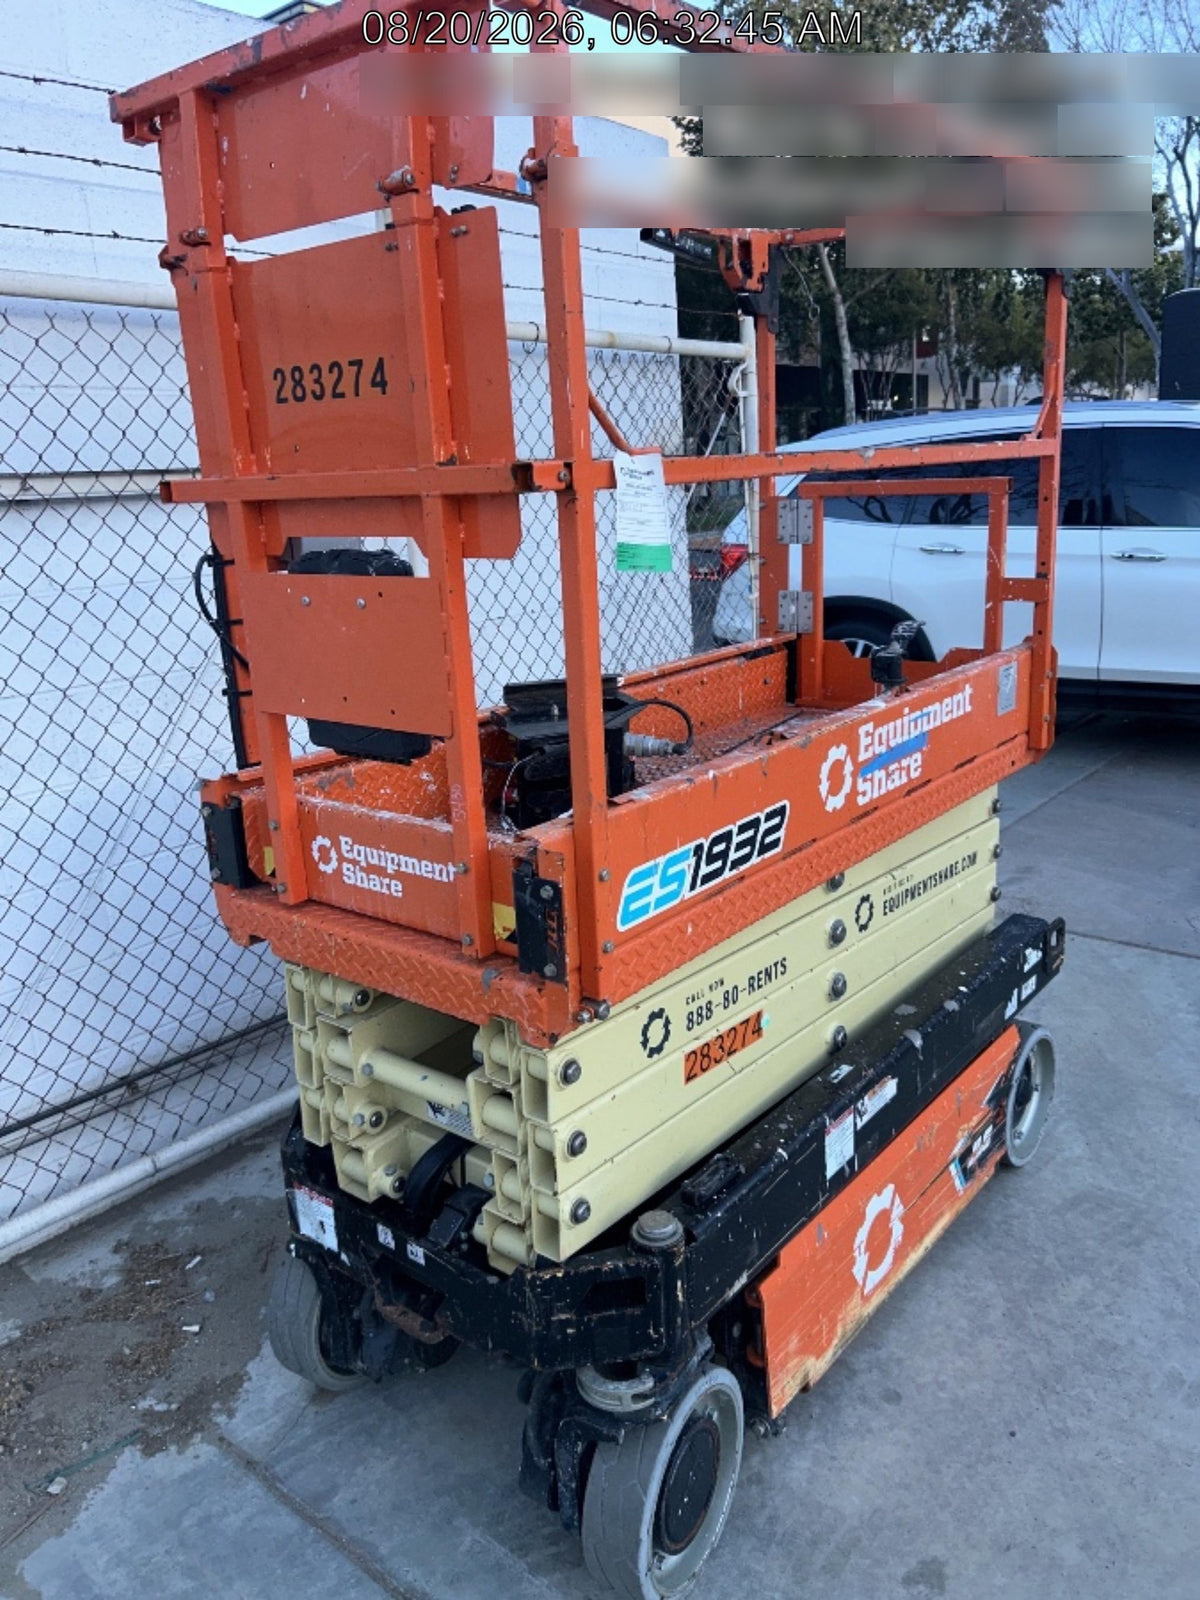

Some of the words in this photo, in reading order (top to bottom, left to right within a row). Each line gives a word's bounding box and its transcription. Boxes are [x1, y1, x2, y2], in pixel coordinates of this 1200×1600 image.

[273, 356, 388, 404] 283274
[858, 683, 973, 762] Equipment
[339, 834, 456, 883] Equipment
[342, 861, 403, 898] Share
[617, 800, 790, 931] ES1932
[685, 957, 787, 1032] 888-80-RENTS
[685, 1010, 763, 1083] 283274
